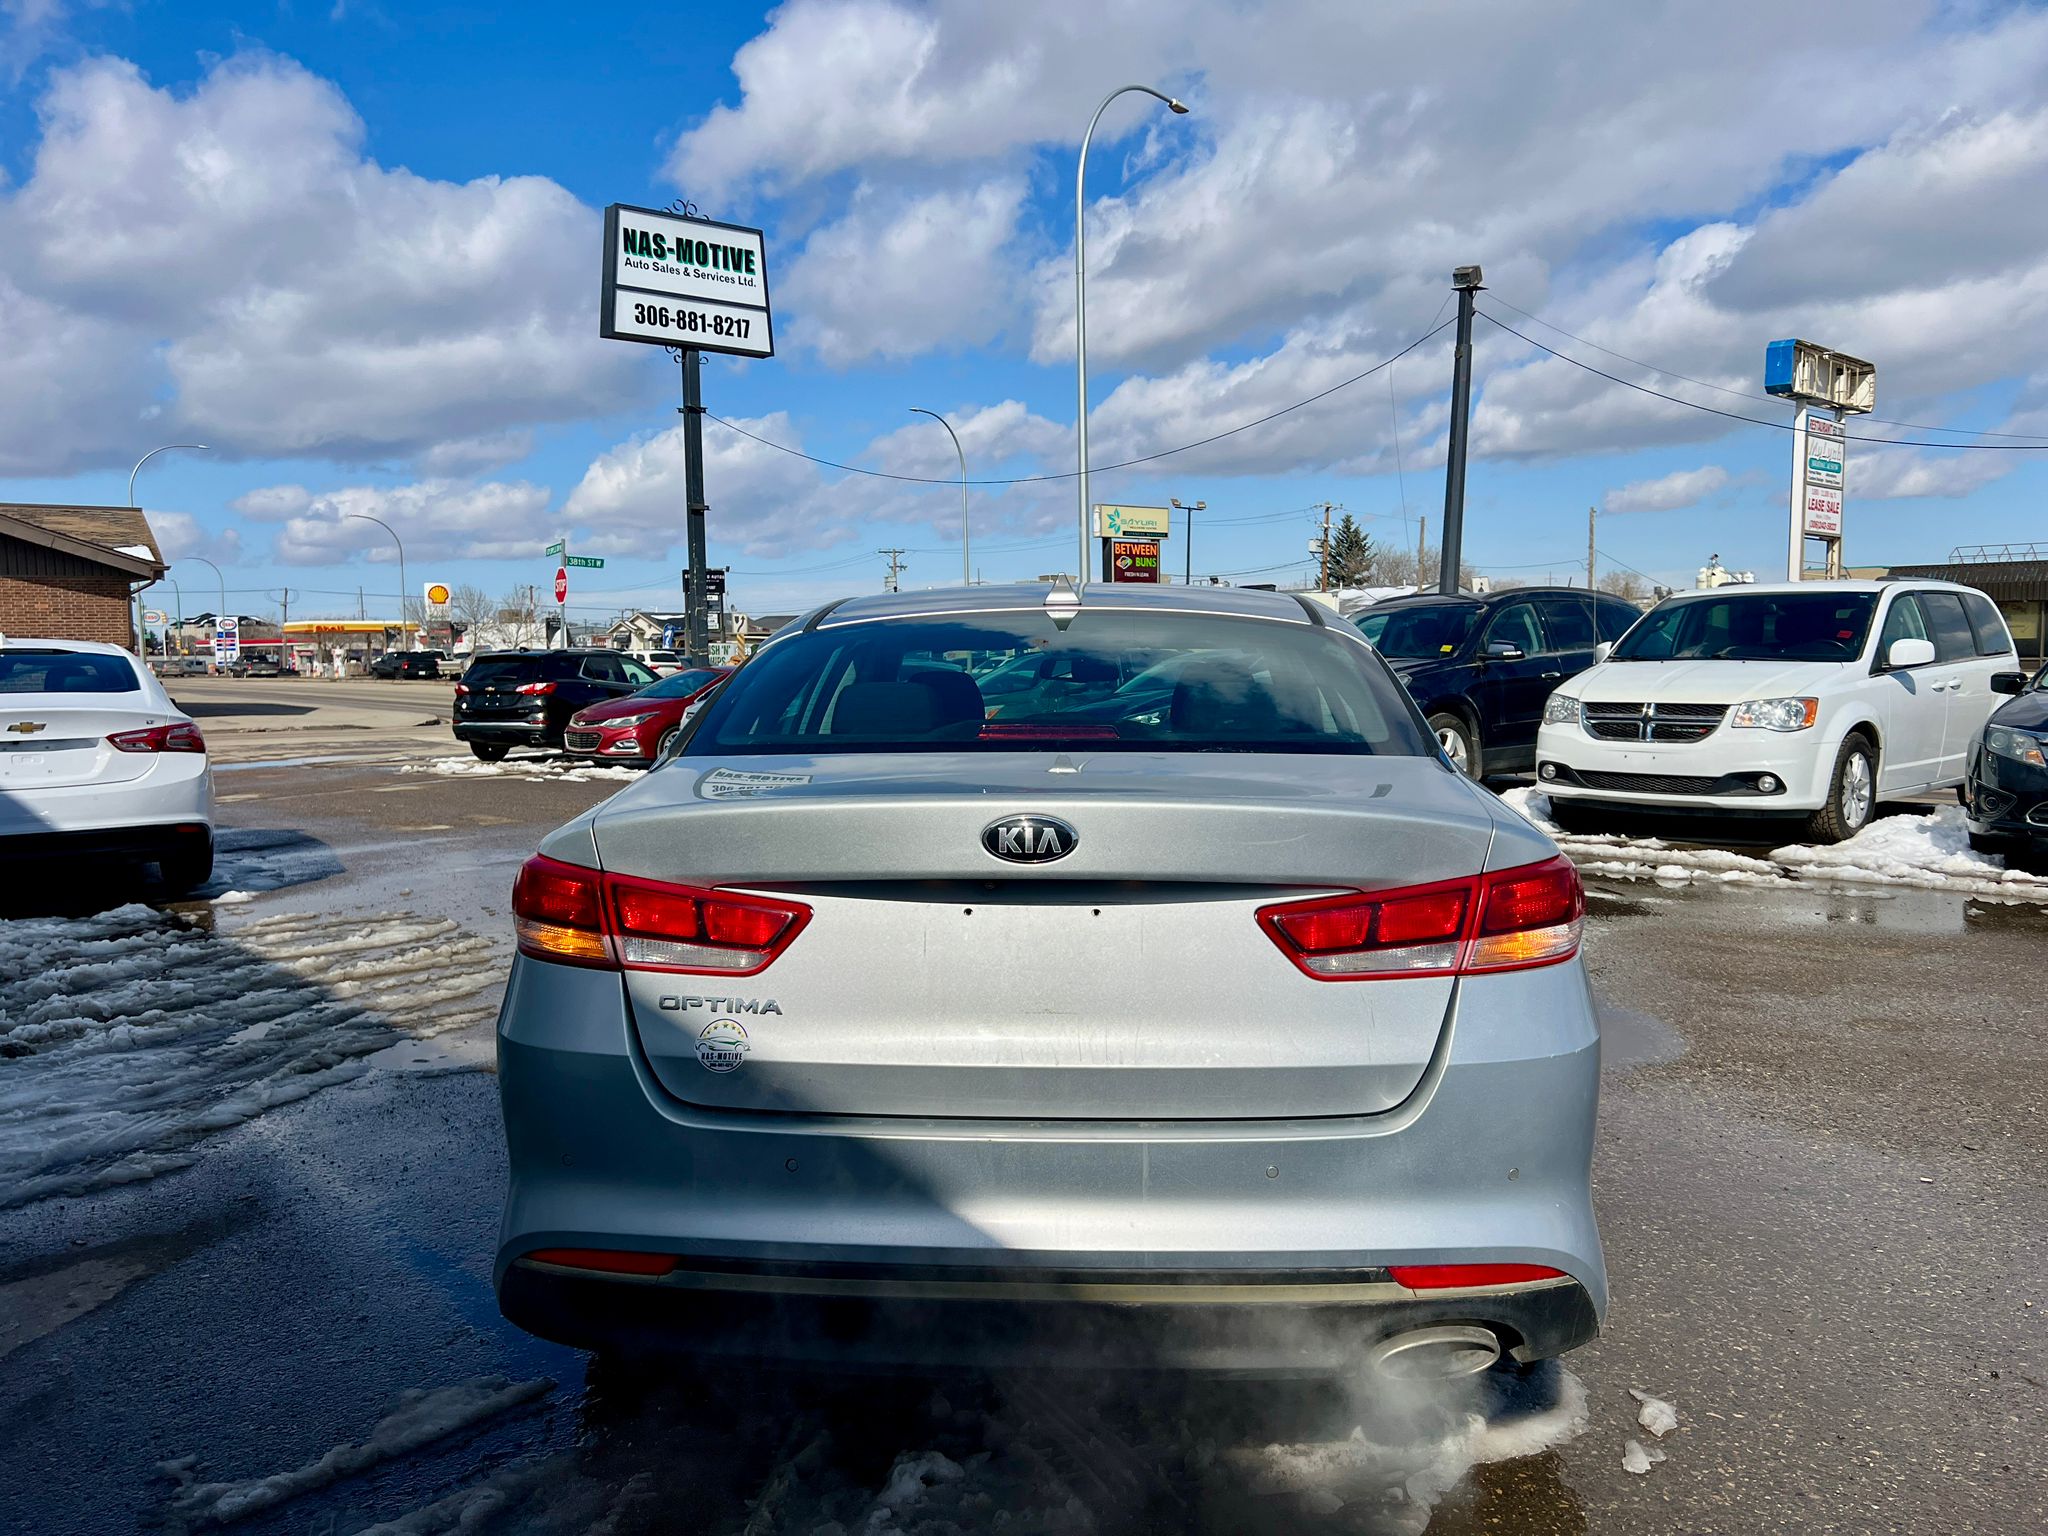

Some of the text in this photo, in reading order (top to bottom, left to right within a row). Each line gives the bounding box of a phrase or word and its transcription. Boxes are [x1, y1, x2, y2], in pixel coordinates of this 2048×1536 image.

[623, 227, 756, 275] NAS-MOTIVE
[624, 257, 757, 288] Auto Sales & Services Ltd.
[634, 303, 750, 339] 306-881-8217
[1808, 498, 1840, 514] LEASE SALE
[1120, 518, 1158, 527] SAYURI
[1114, 543, 1157, 556] BETWEEN
[568, 557, 586, 566] 38th
[1135, 557, 1157, 568] BUNS
[555, 579, 566, 592] STOP
[711, 645, 721, 655] SH
[998, 826, 1062, 853] KIA
[658, 994, 783, 1016] OPTIMA
